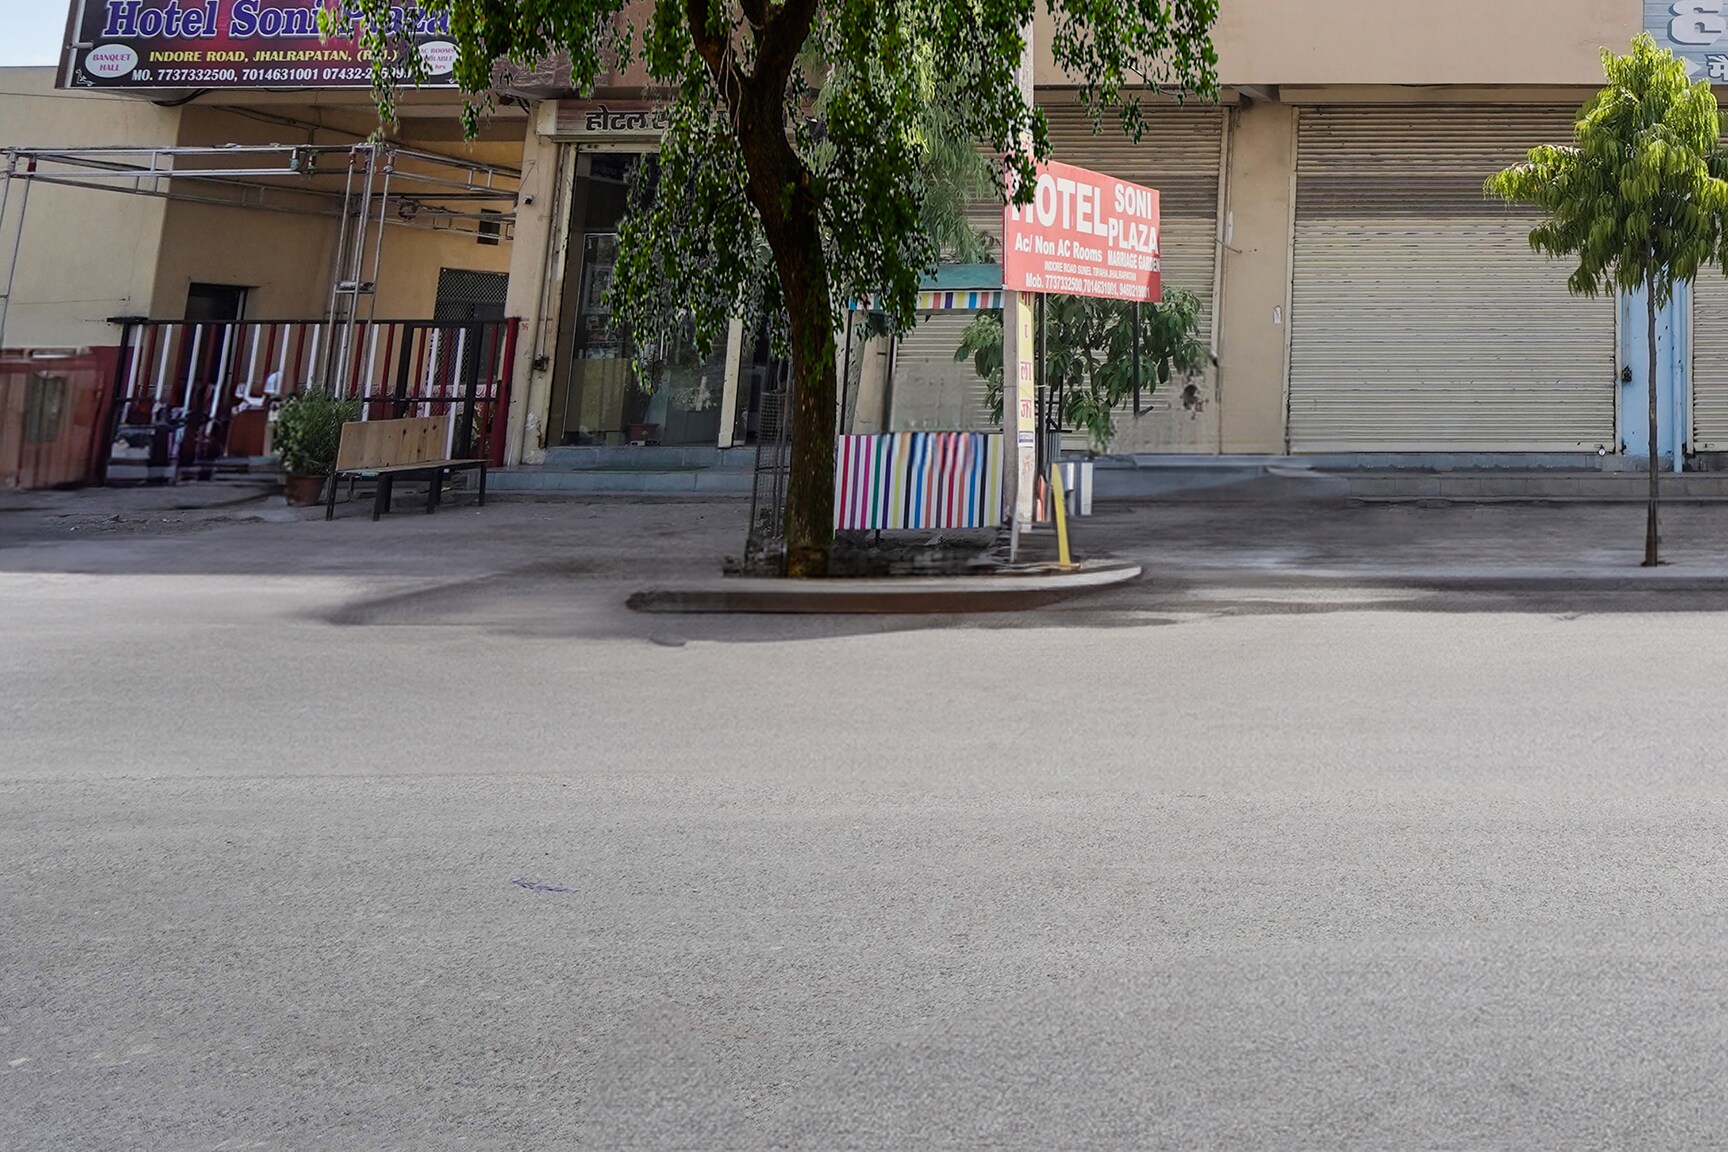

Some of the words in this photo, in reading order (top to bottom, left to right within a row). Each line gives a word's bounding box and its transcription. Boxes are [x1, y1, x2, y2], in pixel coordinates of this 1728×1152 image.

[92, 53, 131, 62] BANQUET
[150, 51, 202, 62] INDORE
[206, 51, 249, 63] ROAD,
[252, 50, 352, 63] JHALRAPATAN,
[99, 64, 120, 72] HALL
[131, 69, 153, 81] MO.
[157, 69, 238, 82] 7737332500,
[242, 68, 318, 81] 7014631001
[585, 105, 649, 131] होटल
[1114, 183, 1152, 219] SONI
[1108, 218, 1159, 254] PLAZA
[1035, 235, 1055, 255] Non
[1057, 239, 1071, 258] AC
[1073, 241, 1103, 263] Rooms
[1107, 250, 1138, 269] MARRIAGE
[1025, 273, 1044, 289] Mob.
